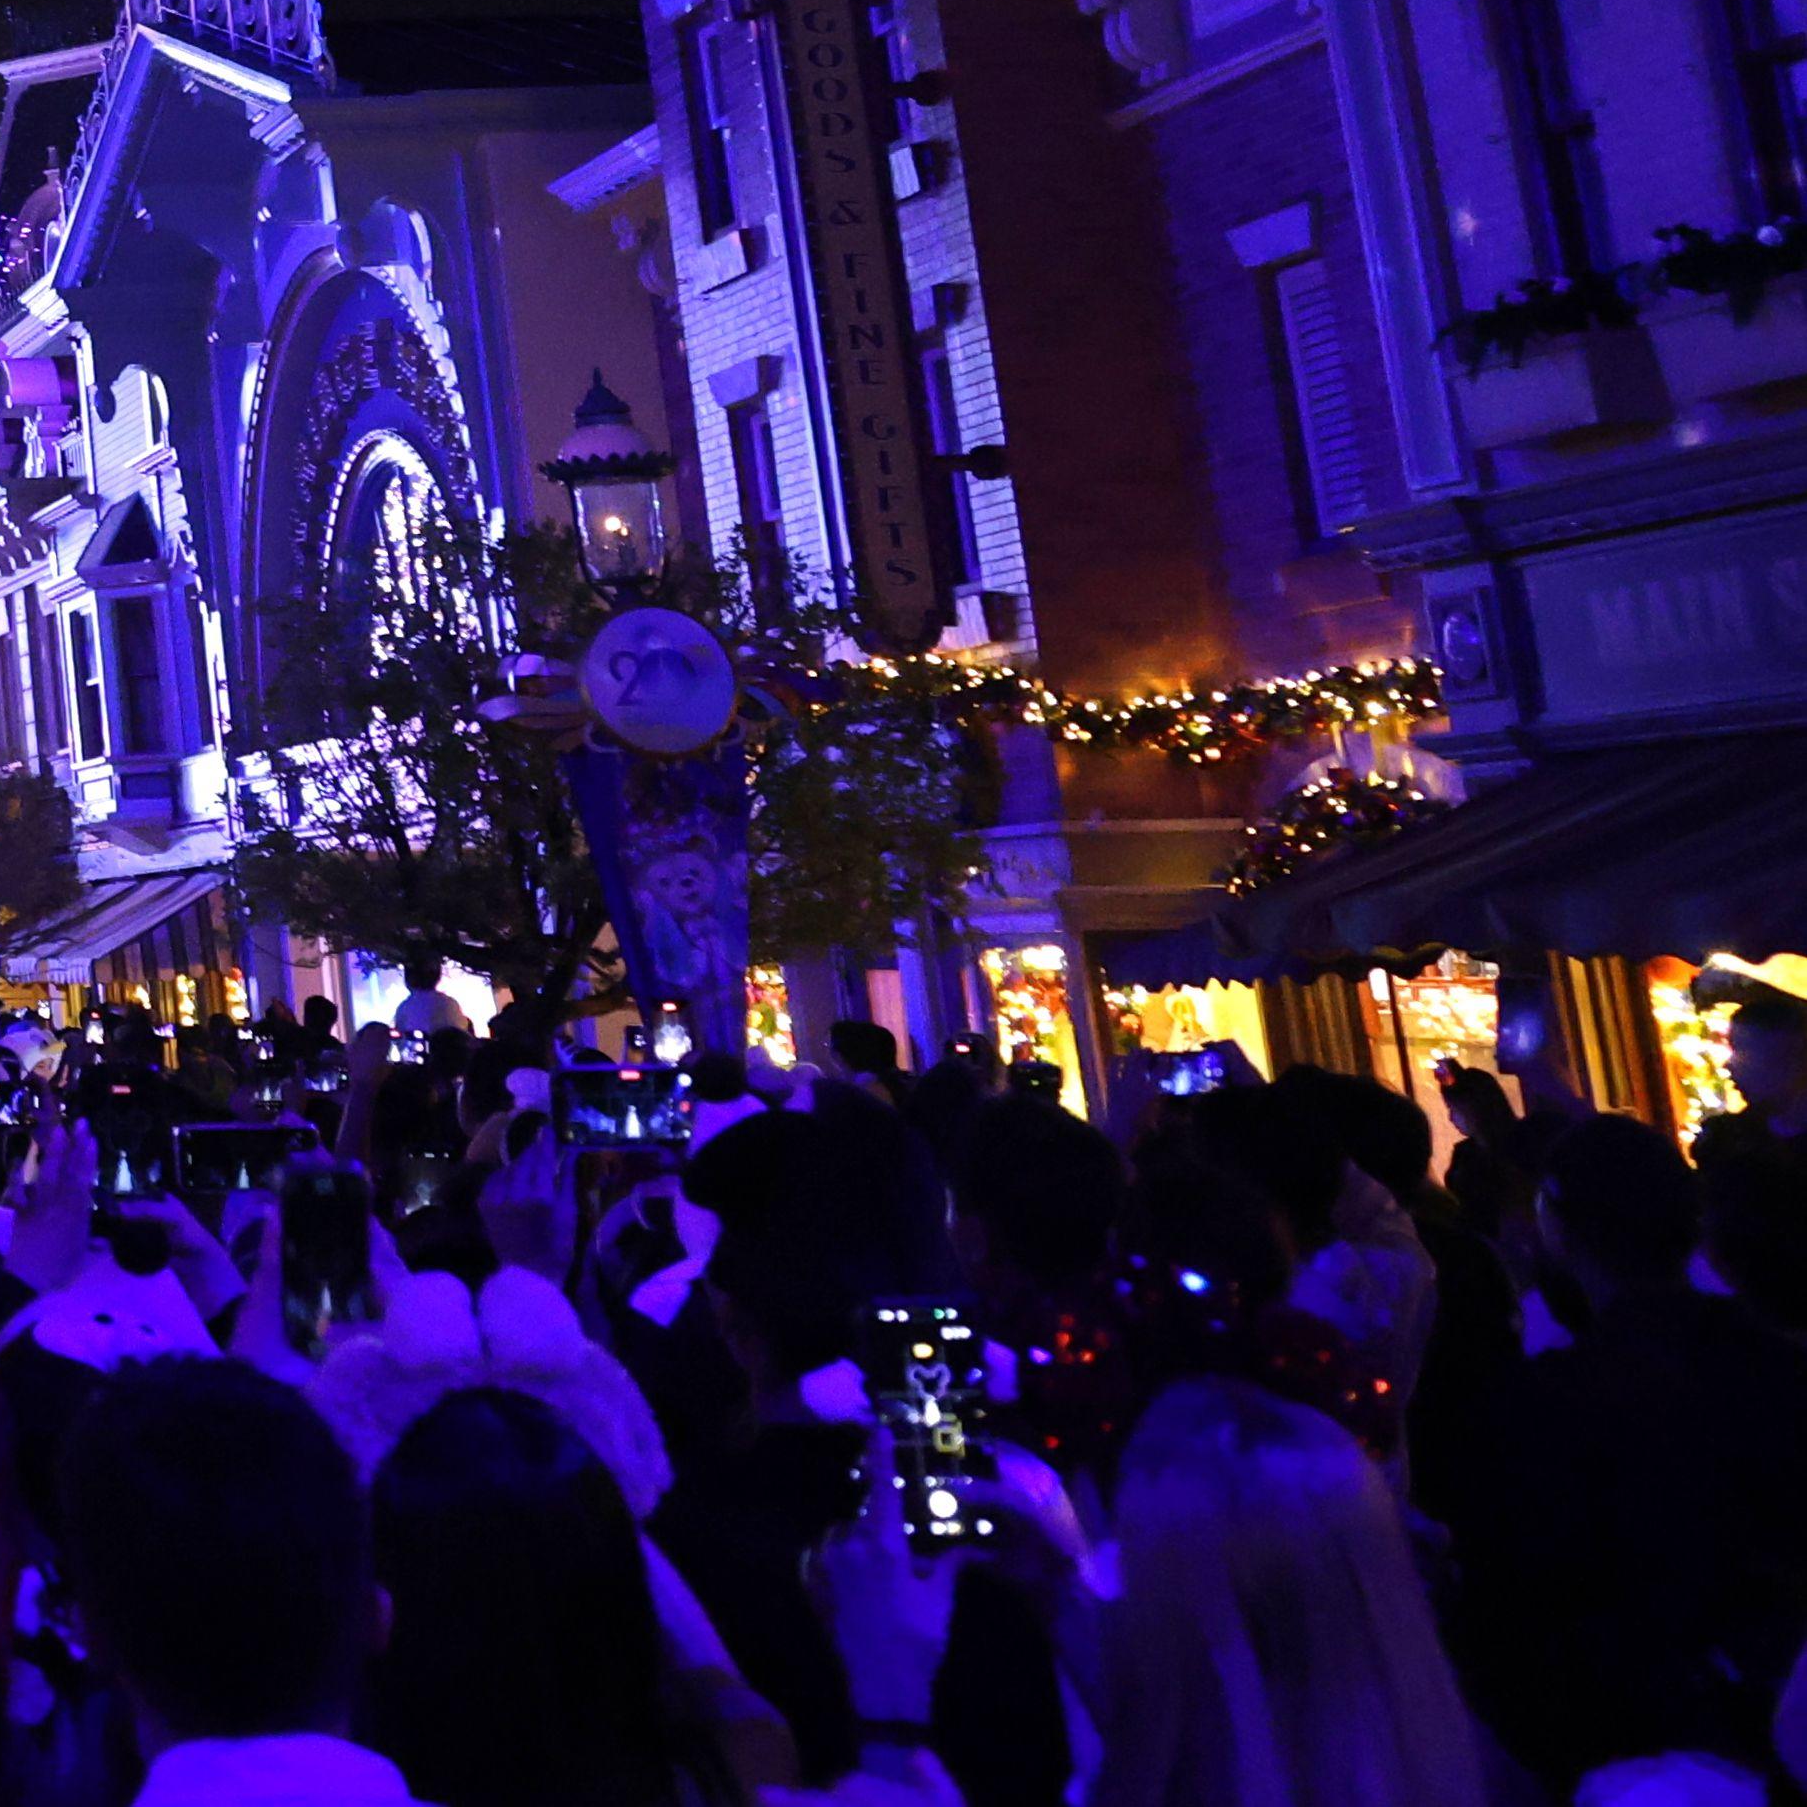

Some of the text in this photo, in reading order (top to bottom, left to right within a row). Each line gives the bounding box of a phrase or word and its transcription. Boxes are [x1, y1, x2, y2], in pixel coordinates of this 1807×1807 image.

[801, 8, 917, 587] GOODS & FINE GIFTS
